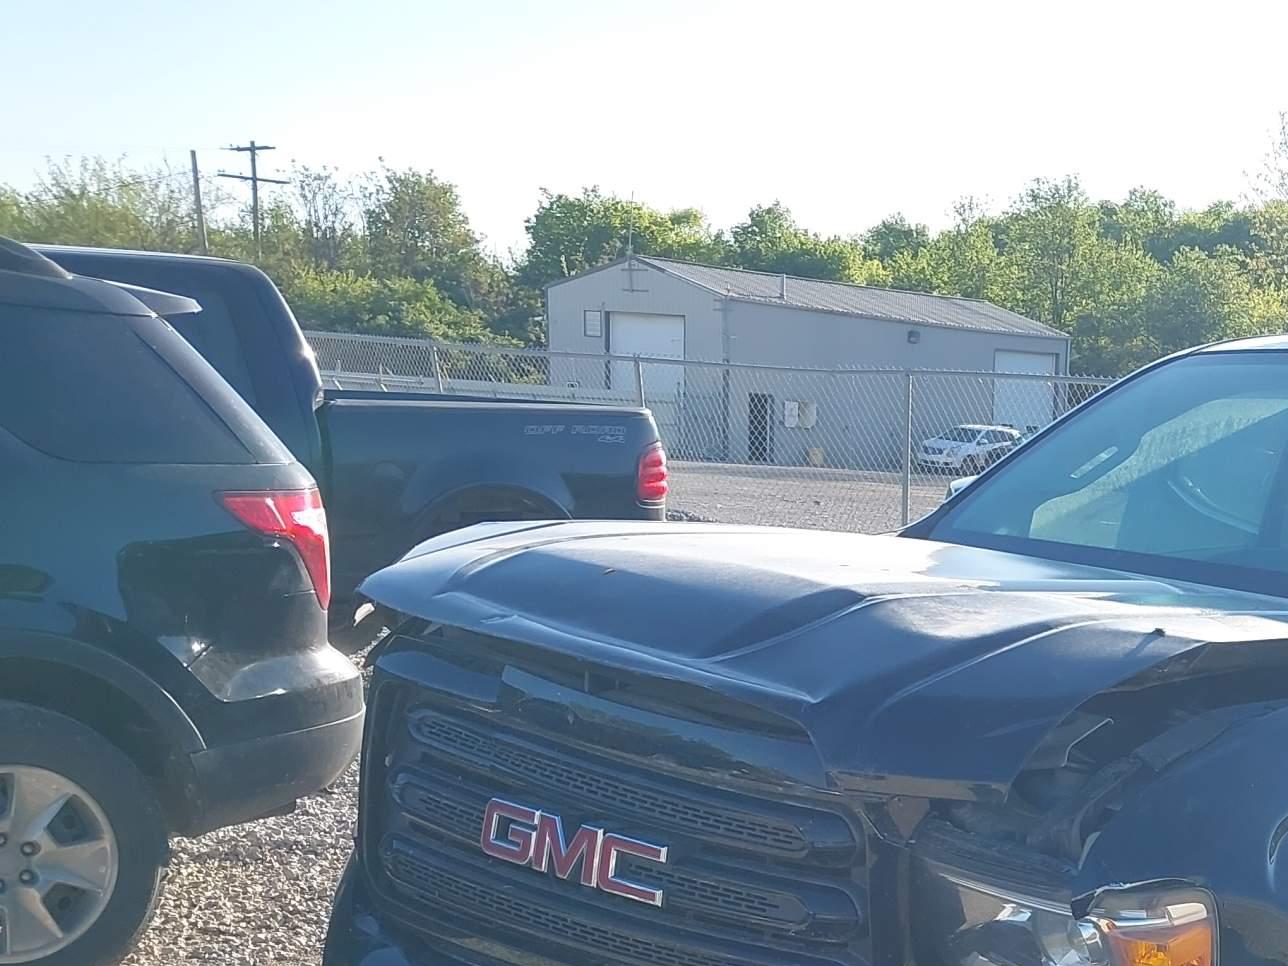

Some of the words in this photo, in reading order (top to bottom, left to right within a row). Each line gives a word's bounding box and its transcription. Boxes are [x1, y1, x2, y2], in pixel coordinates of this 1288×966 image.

[524, 425, 565, 435] OFF
[571, 425, 626, 435] ROAD
[481, 798, 668, 907] GMC
